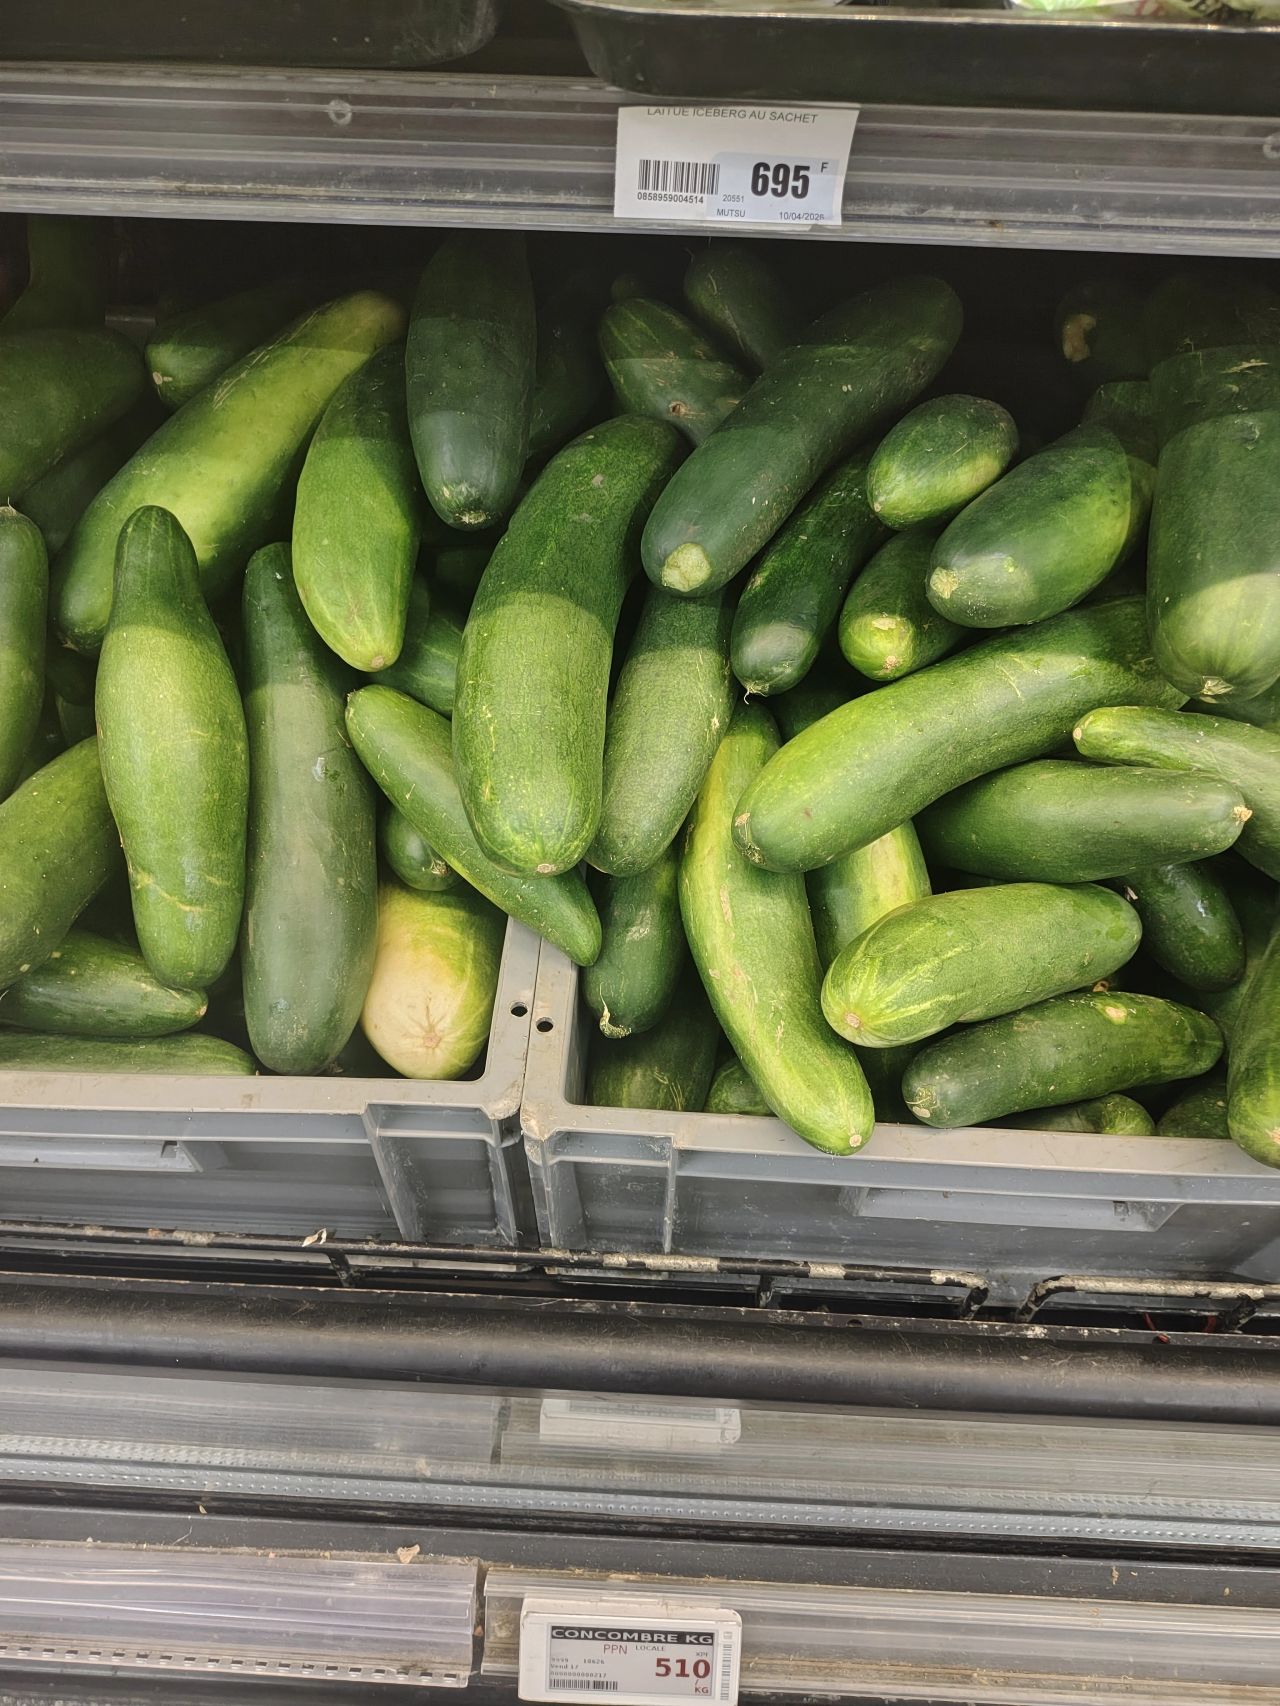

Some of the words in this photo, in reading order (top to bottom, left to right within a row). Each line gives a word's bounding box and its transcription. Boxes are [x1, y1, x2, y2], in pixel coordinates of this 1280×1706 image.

[693, 108, 746, 119] ICEBERG
[749, 110, 766, 120] AU
[769, 112, 818, 123] SACHET
[820, 162, 829, 173] F
[751, 162, 810, 199] 695
[637, 191, 704, 204] 0858959004514
[722, 194, 745, 203] 20551
[716, 208, 746, 218] MUTSU
[552, 1629, 678, 1643] CONCOMBRE
[685, 1634, 713, 1644] KG
[603, 1643, 628, 1655] PPN
[655, 1657, 711, 1679] 510
[694, 1686, 709, 1694] KG
